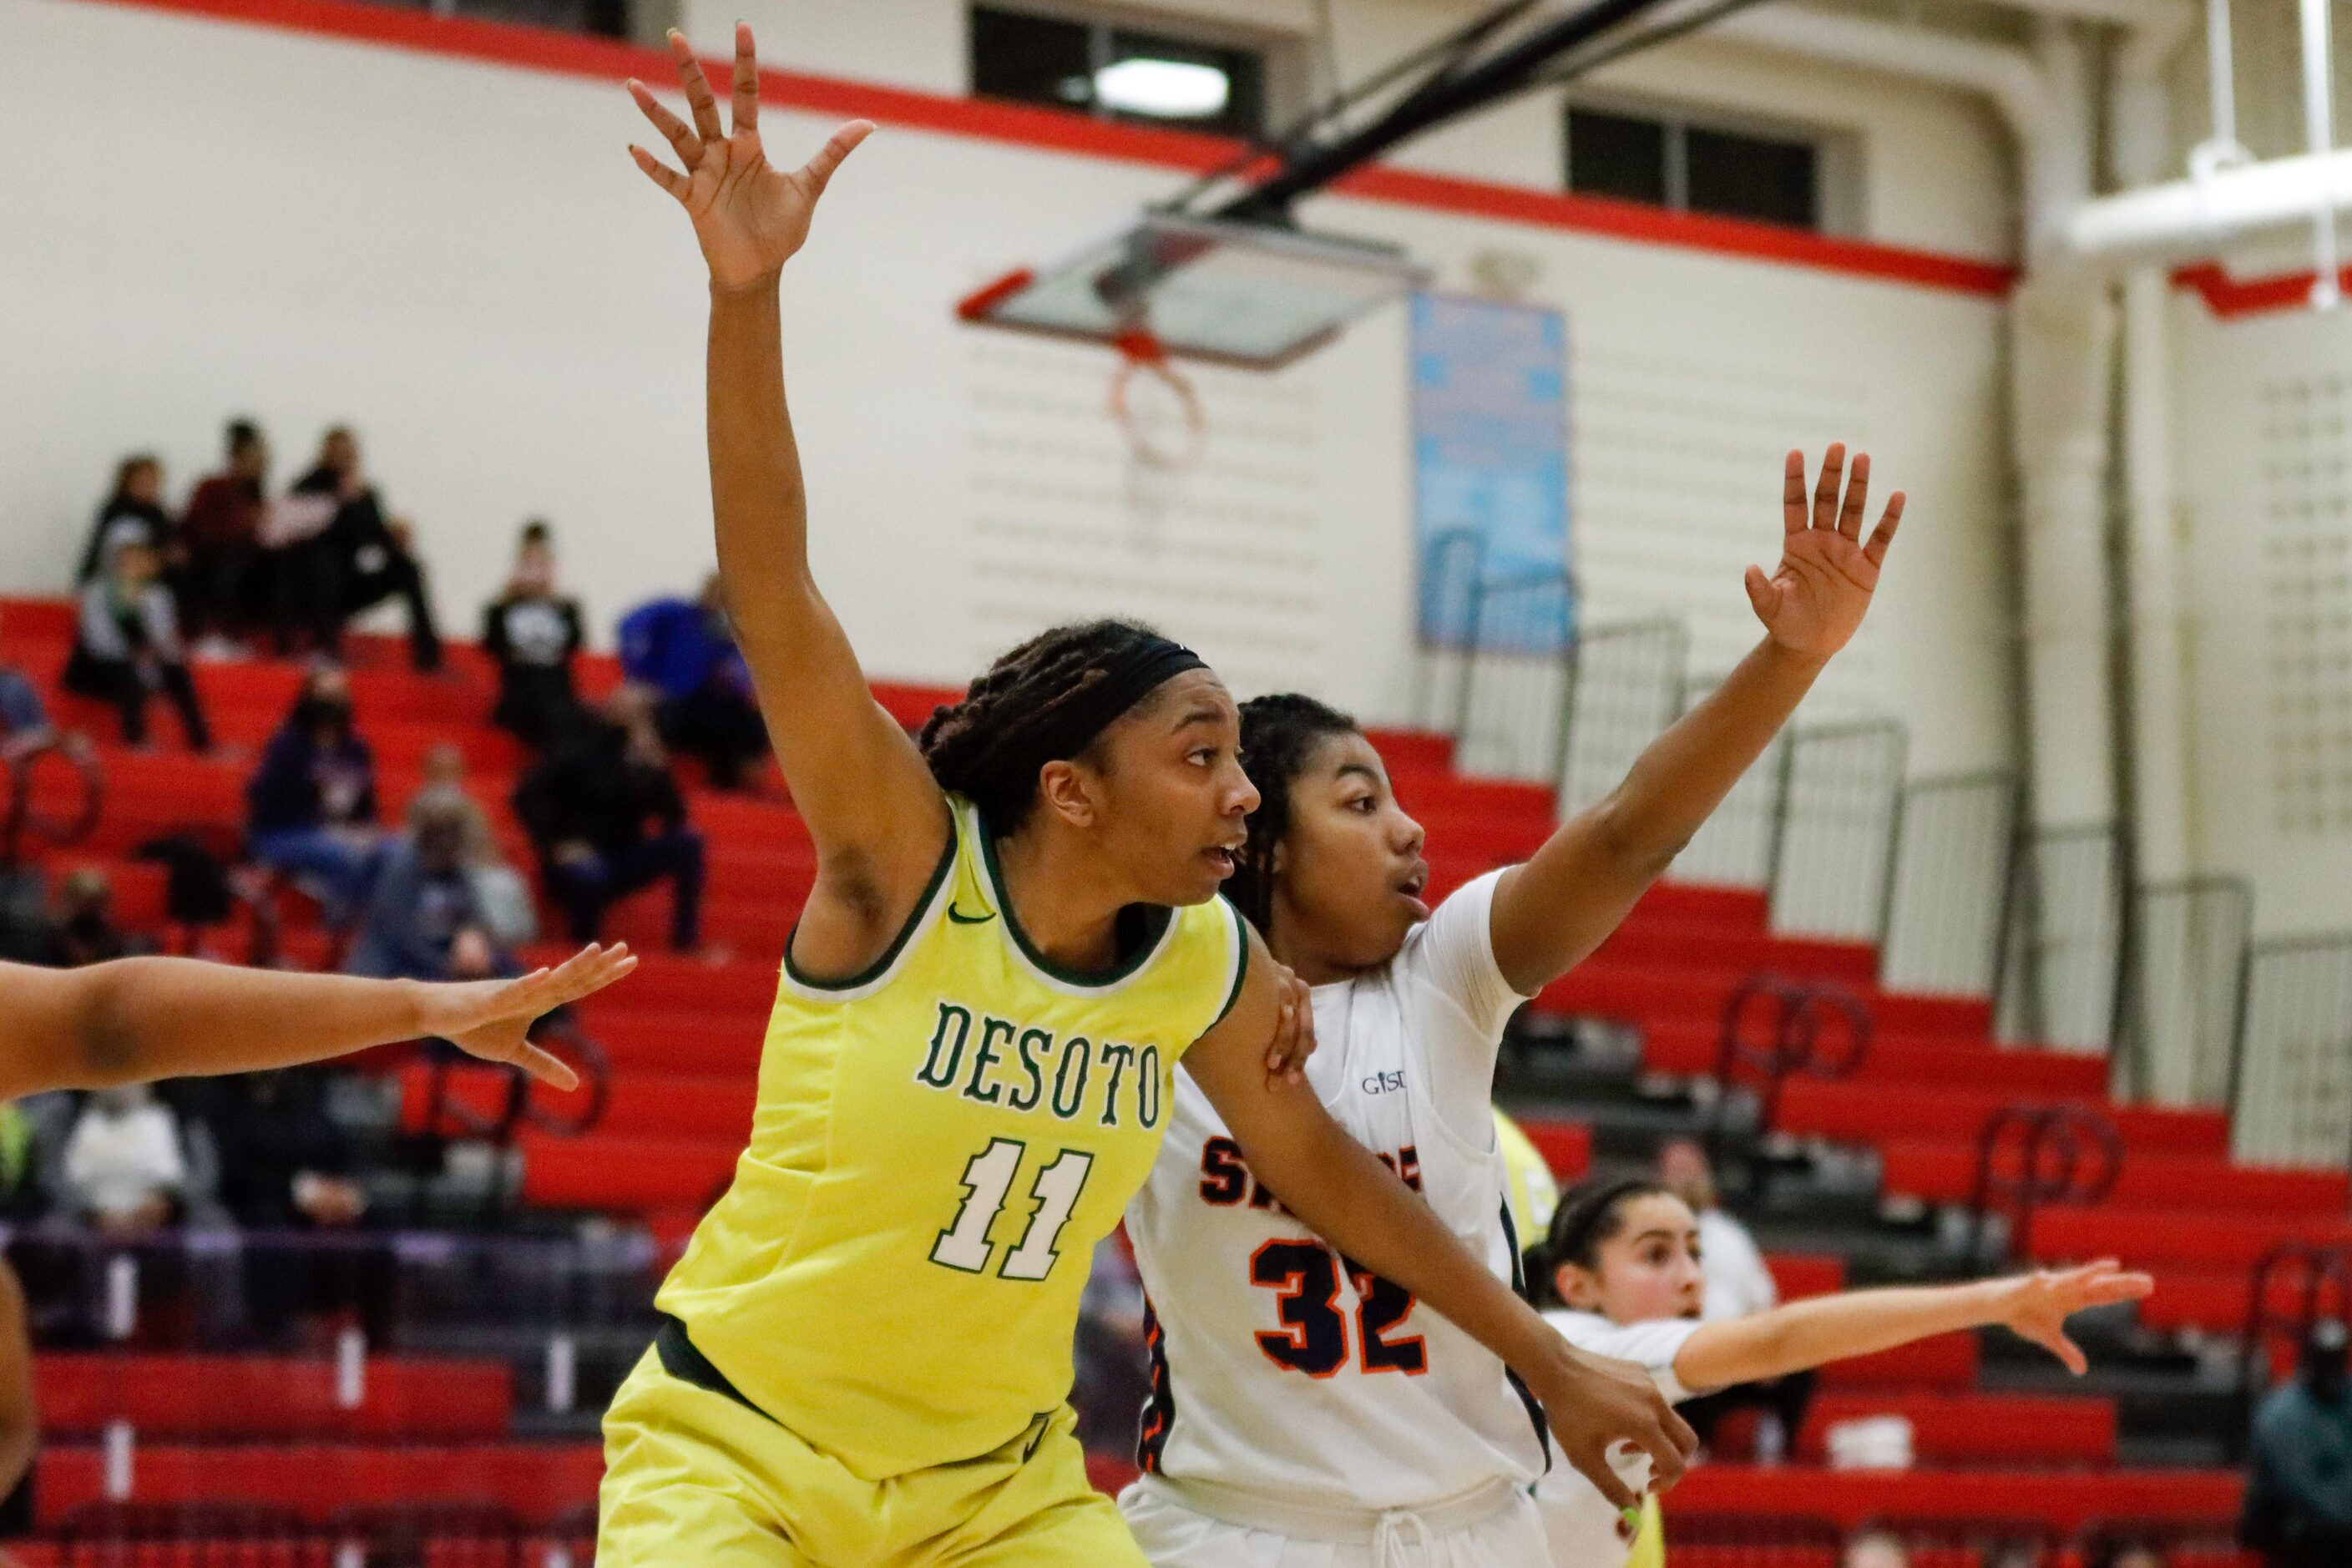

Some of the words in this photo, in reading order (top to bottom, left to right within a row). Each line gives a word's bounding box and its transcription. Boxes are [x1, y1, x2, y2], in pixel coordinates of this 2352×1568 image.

[916, 1001, 1161, 1130] DESOTO
[928, 1136, 1095, 1282] 11
[1249, 1237, 1429, 1379] 32
